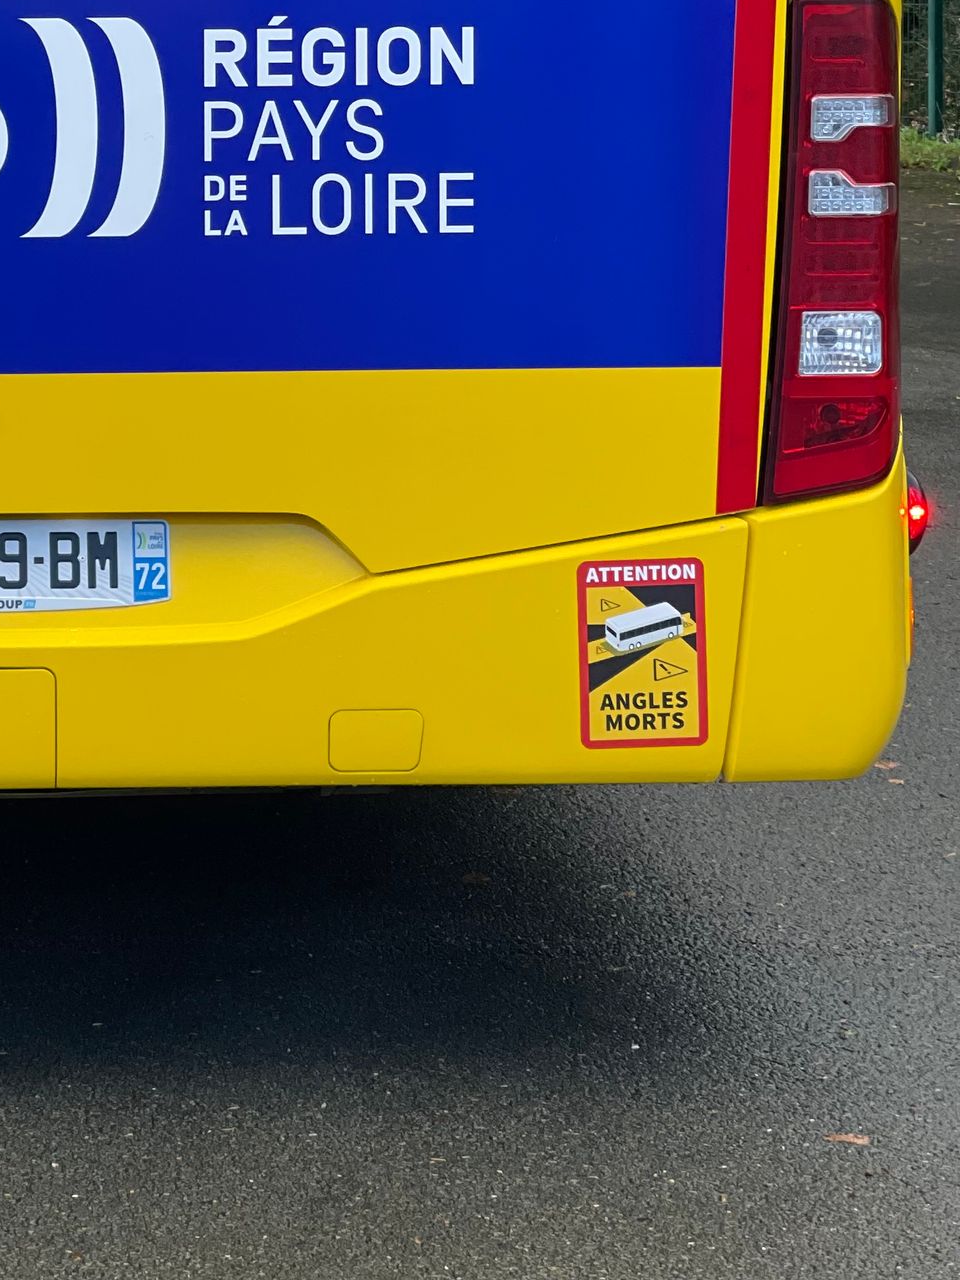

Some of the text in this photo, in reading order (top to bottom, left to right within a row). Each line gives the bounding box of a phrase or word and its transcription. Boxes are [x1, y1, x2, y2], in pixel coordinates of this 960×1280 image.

[203, 15, 475, 88] RÉGION
[203, 98, 385, 162] PAYS
[203, 174, 247, 201] DE
[203, 172, 475, 236] LA LOIRE
[135, 562, 166, 590] 72
[585, 563, 696, 584] ATTENTION
[599, 690, 689, 711] ANGLES
[605, 712, 686, 732] MORTS
